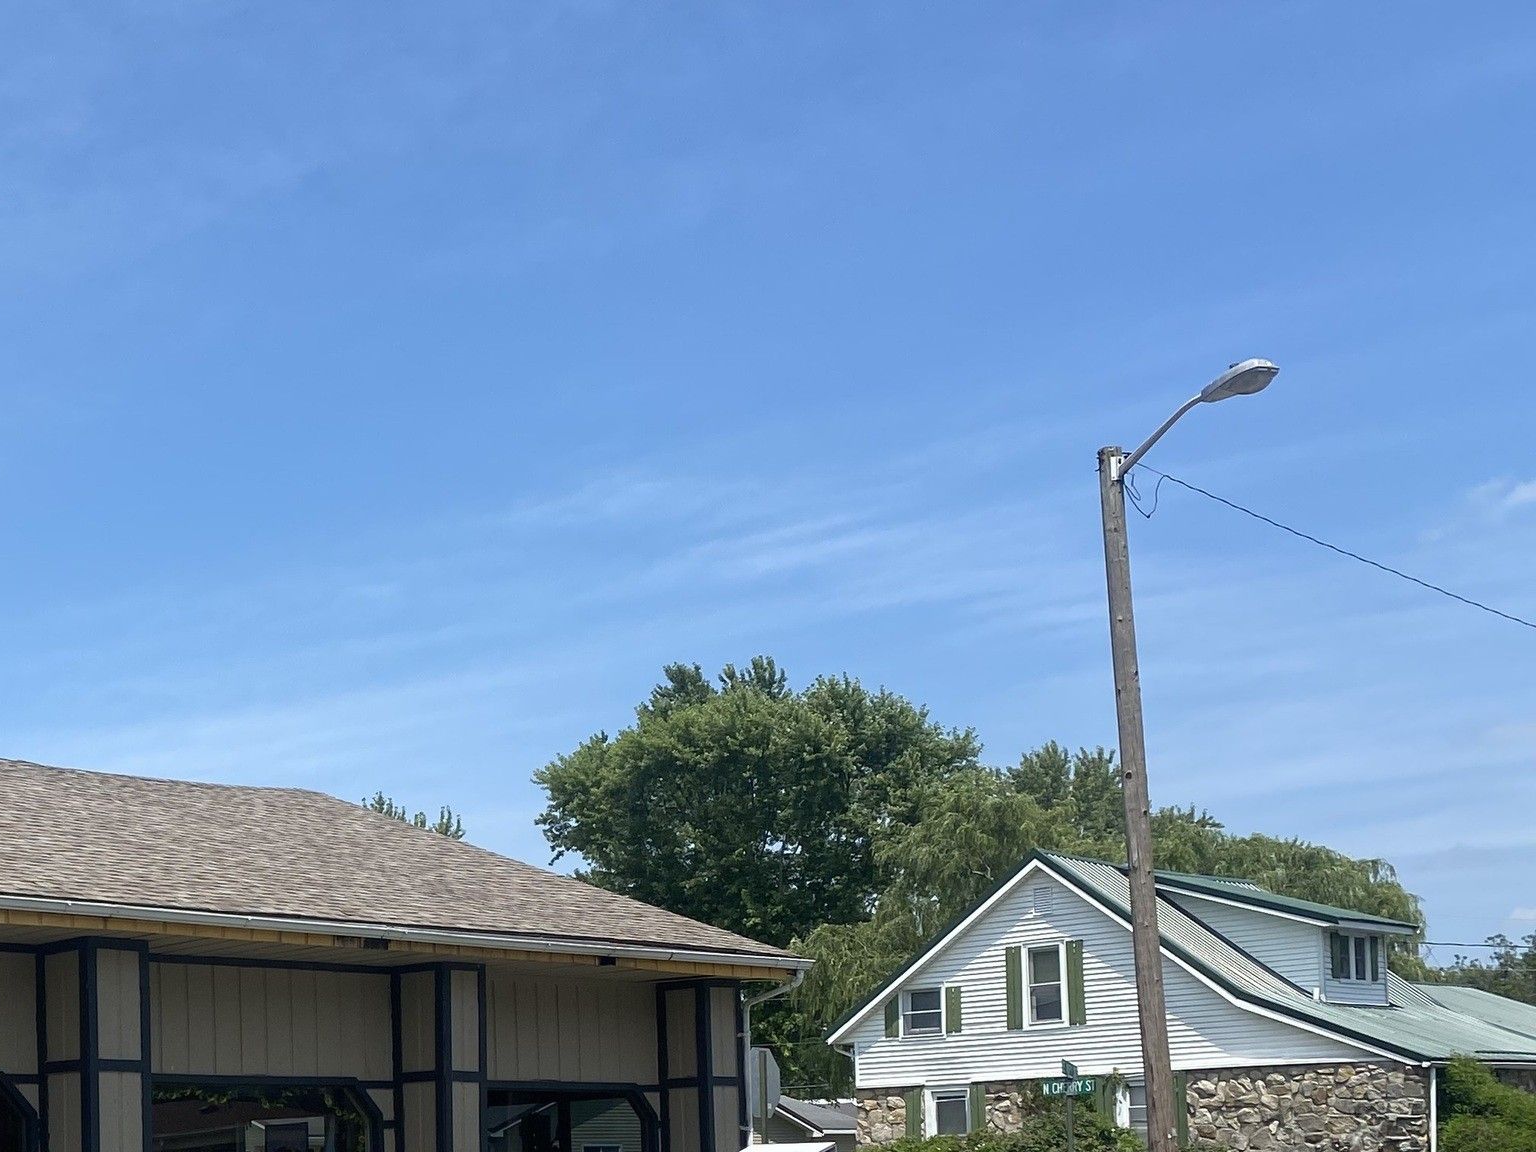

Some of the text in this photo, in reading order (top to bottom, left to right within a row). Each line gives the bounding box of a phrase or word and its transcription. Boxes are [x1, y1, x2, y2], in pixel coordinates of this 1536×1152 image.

[1043, 1079, 1095, 1095] N CHRY ST
